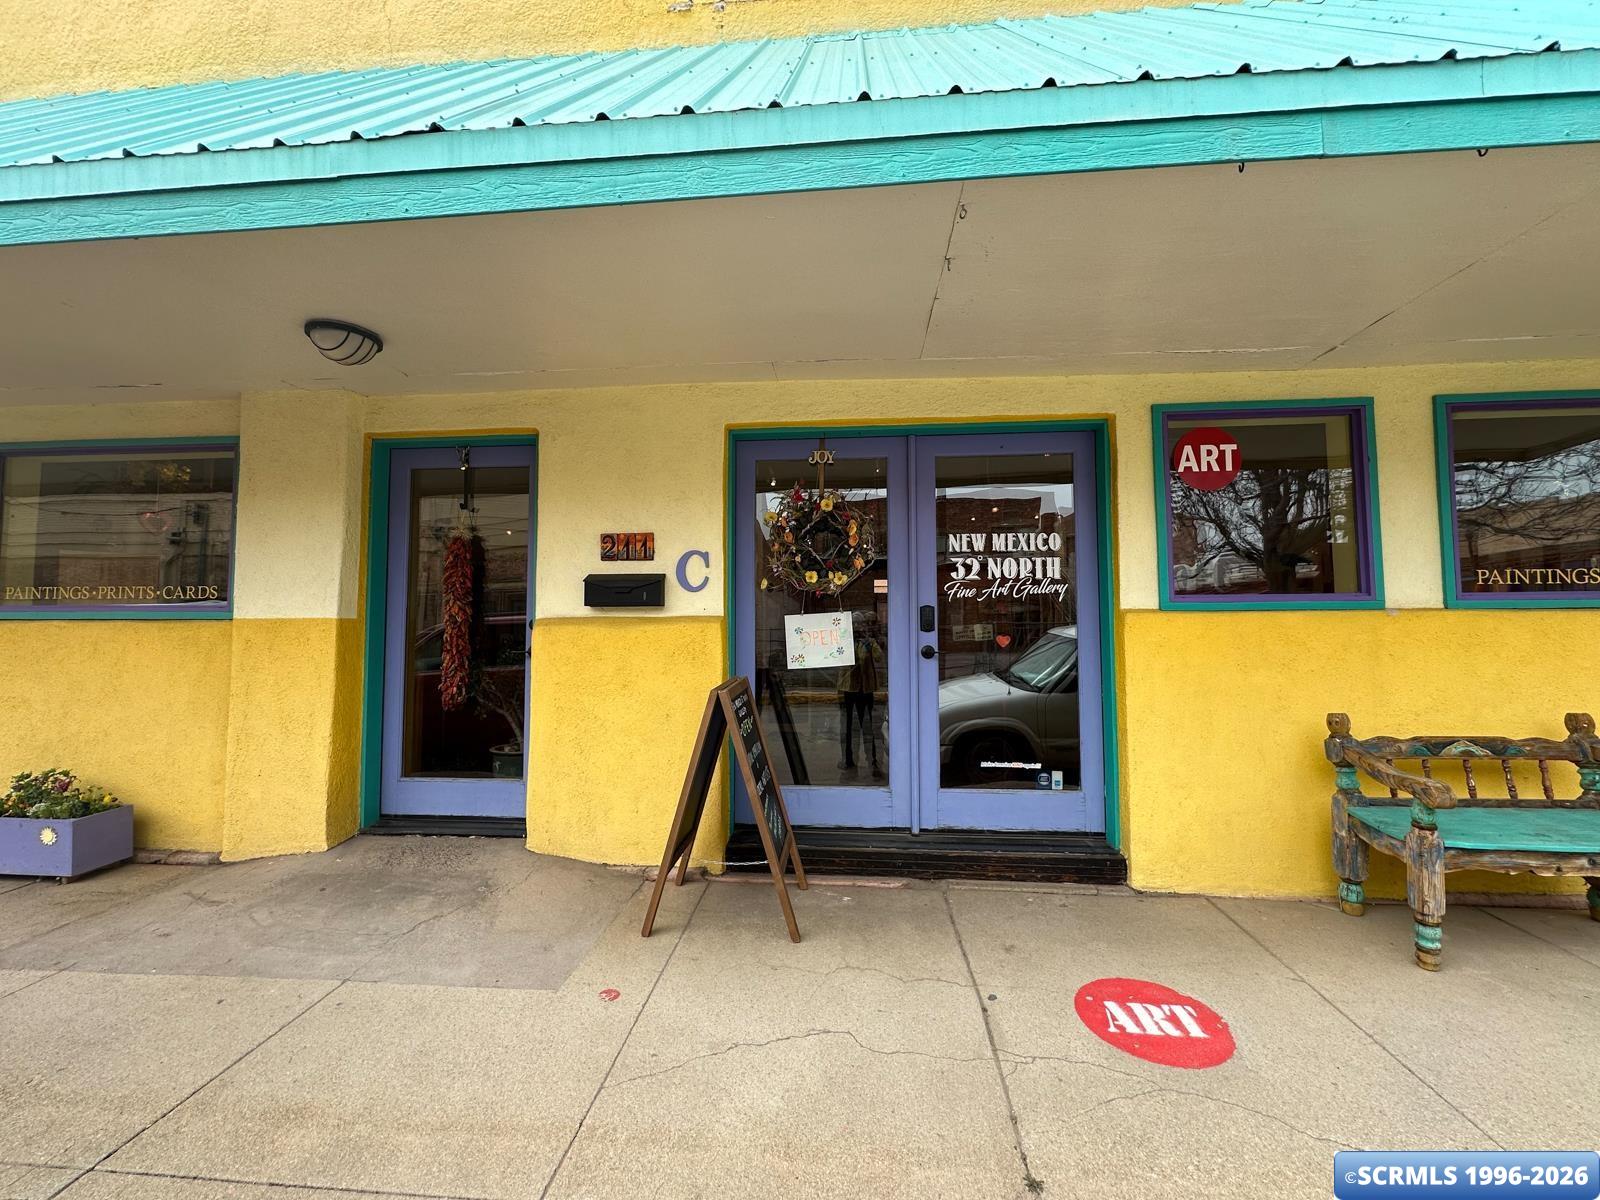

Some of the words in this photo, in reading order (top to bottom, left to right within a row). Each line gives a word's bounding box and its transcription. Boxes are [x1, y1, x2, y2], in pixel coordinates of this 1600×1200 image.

[808, 450, 836, 464] JOY
[1177, 443, 1238, 473] ART
[601, 534, 650, 560] 211
[948, 533, 987, 552] NEW
[991, 532, 1062, 552] MEXICO
[675, 549, 710, 593] C
[987, 556, 1062, 580] NORTH
[1475, 567, 1600, 586] PAINTINGS
[5, 585, 90, 600] PAINTINGS
[98, 585, 155, 600] PRINTS
[162, 585, 219, 600] CARDS
[943, 579, 977, 602] Fine
[976, 577, 1016, 602] Art
[1012, 576, 1069, 602] Gallery
[800, 628, 841, 646] OPEN
[1102, 1000, 1211, 1039] ART
